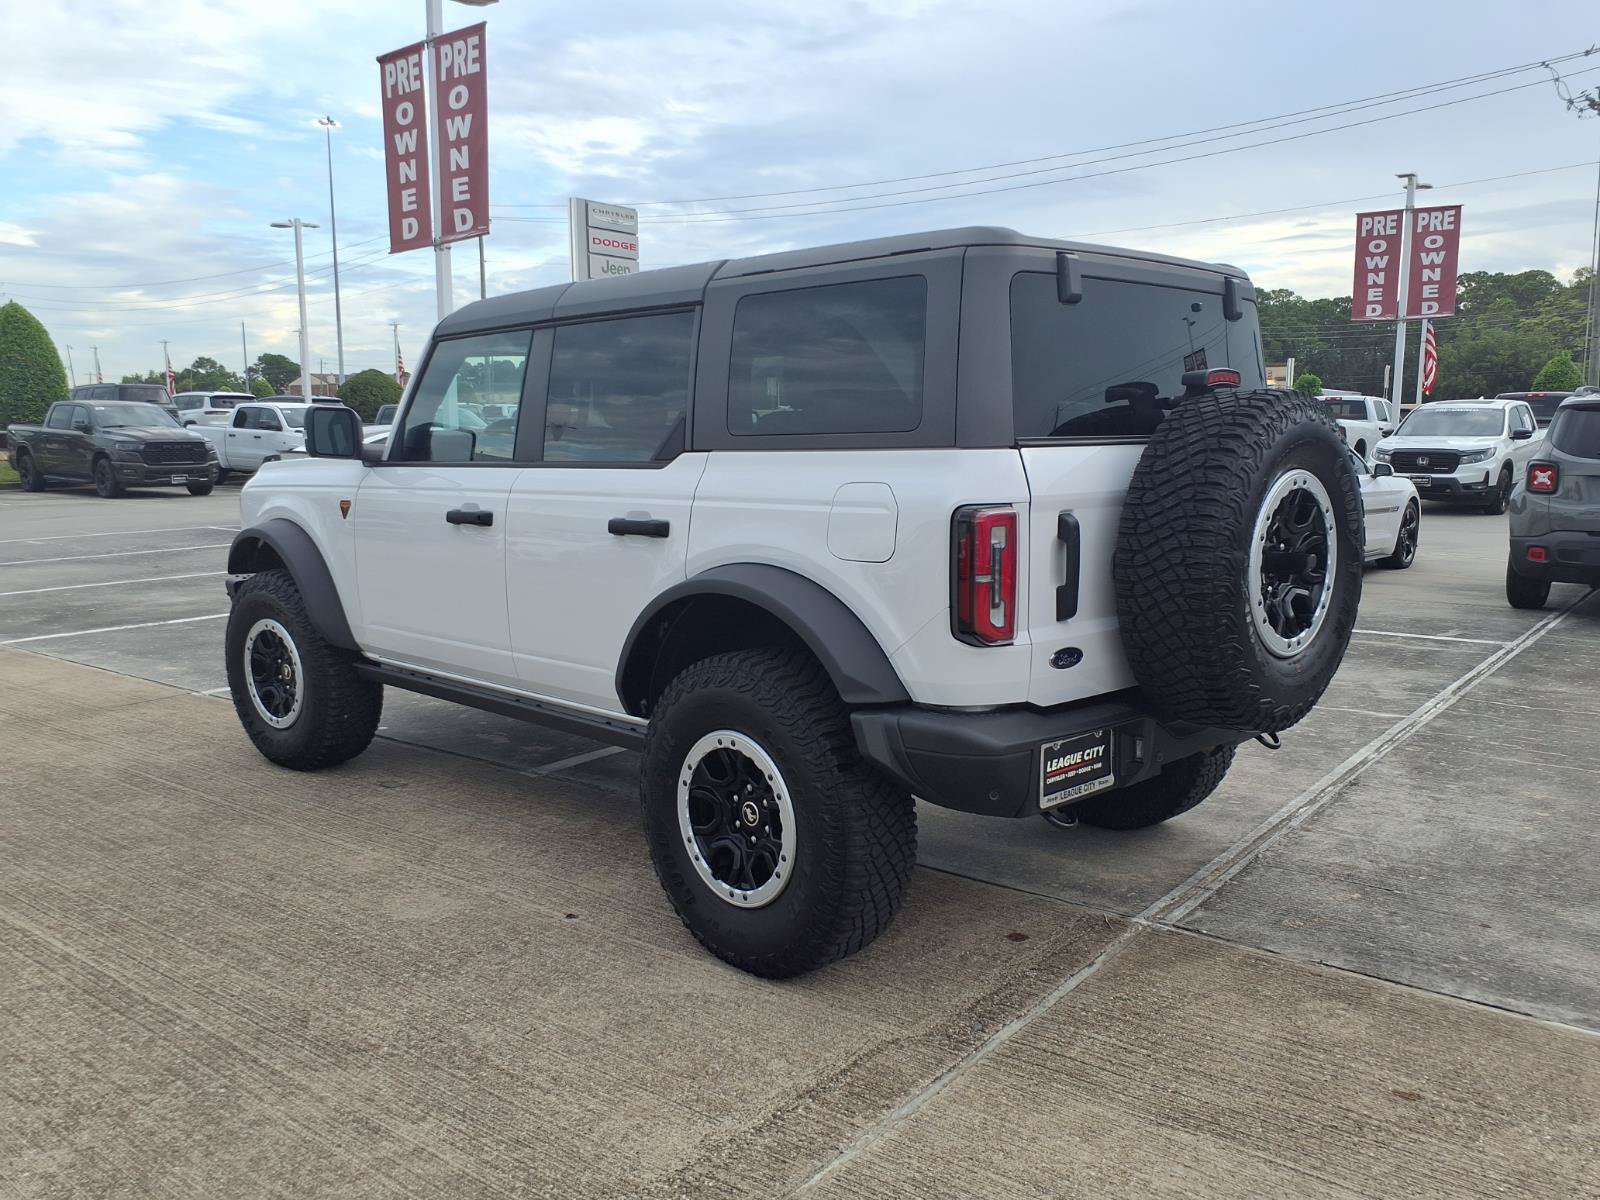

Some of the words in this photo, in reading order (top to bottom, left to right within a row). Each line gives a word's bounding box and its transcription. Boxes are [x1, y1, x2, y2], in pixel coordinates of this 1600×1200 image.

[384, 54, 421, 98] PRE
[440, 35, 480, 81] PRE
[394, 102, 419, 240] OWNED
[446, 85, 474, 232] OWNED
[592, 208, 635, 220] CHRYSLER
[1361, 215, 1398, 237] PRE
[1416, 209, 1456, 233] PRE
[592, 237, 637, 251] DODGE
[1365, 239, 1389, 317] OWNED
[1419, 235, 1446, 315] OWNED
[1046, 751, 1083, 772] LEAGUE
[1084, 744, 1105, 760] CITY
[1060, 785, 1083, 800] LEAGUE
[1083, 782, 1096, 792] CITY
